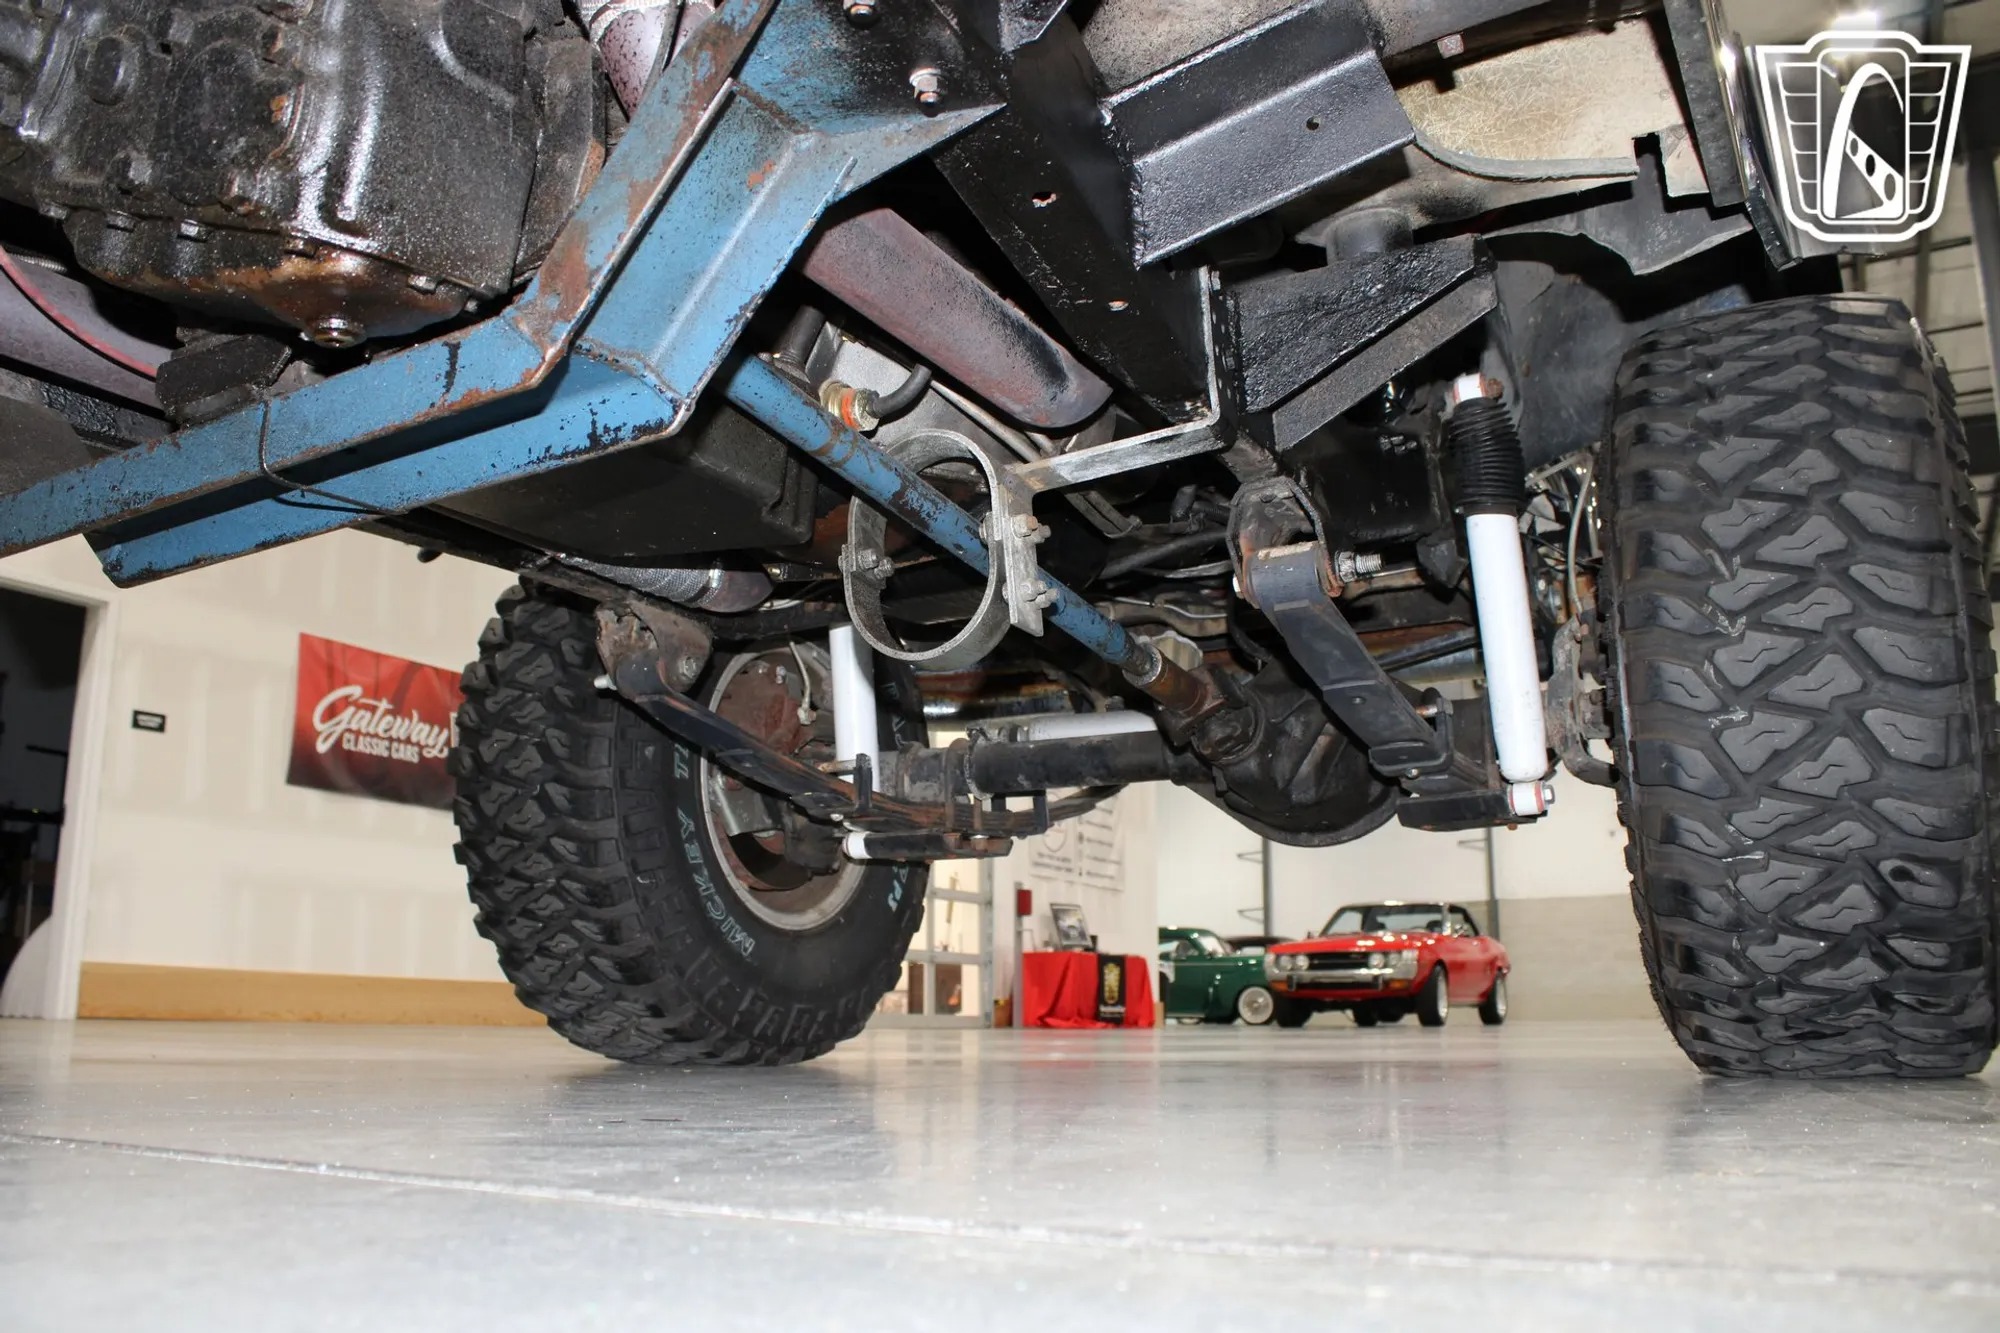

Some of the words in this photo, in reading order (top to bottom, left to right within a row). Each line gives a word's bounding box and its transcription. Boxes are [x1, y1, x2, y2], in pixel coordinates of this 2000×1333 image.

[312, 684, 450, 759] Gateway
[342, 732, 390, 759] CLASSIC
[390, 740, 420, 764] CARS
[677, 806, 756, 957] MICKEY
